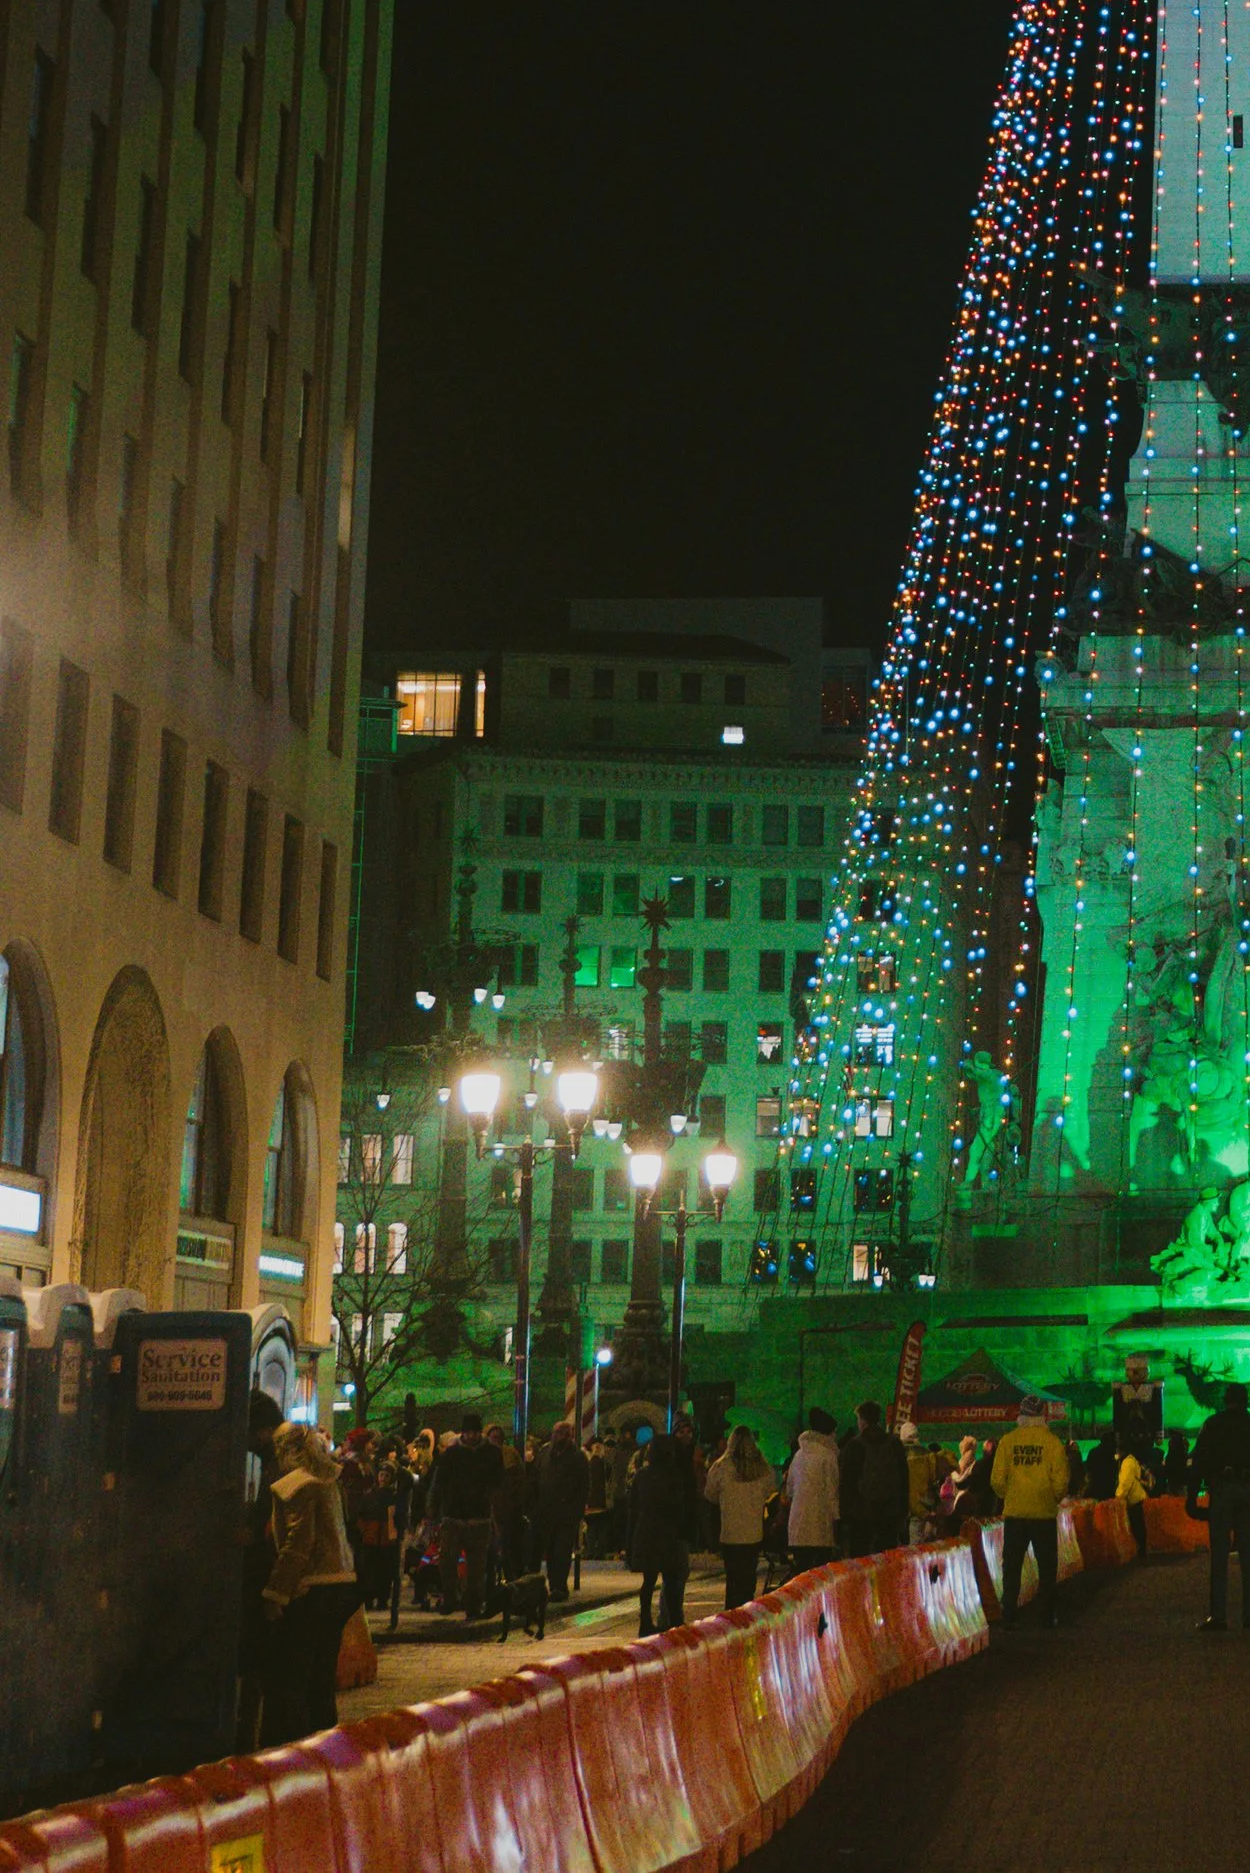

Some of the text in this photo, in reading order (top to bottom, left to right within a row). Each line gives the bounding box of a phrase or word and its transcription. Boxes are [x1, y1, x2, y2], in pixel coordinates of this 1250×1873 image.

[143, 1348, 221, 1368] Service
[899, 1334, 920, 1395] TICKET
[141, 1369, 220, 1383] Sanitation
[964, 1406, 1008, 1418] LOTTERY
[1013, 1445, 1044, 1455] EVENT
[1013, 1455, 1043, 1466] STAFF
